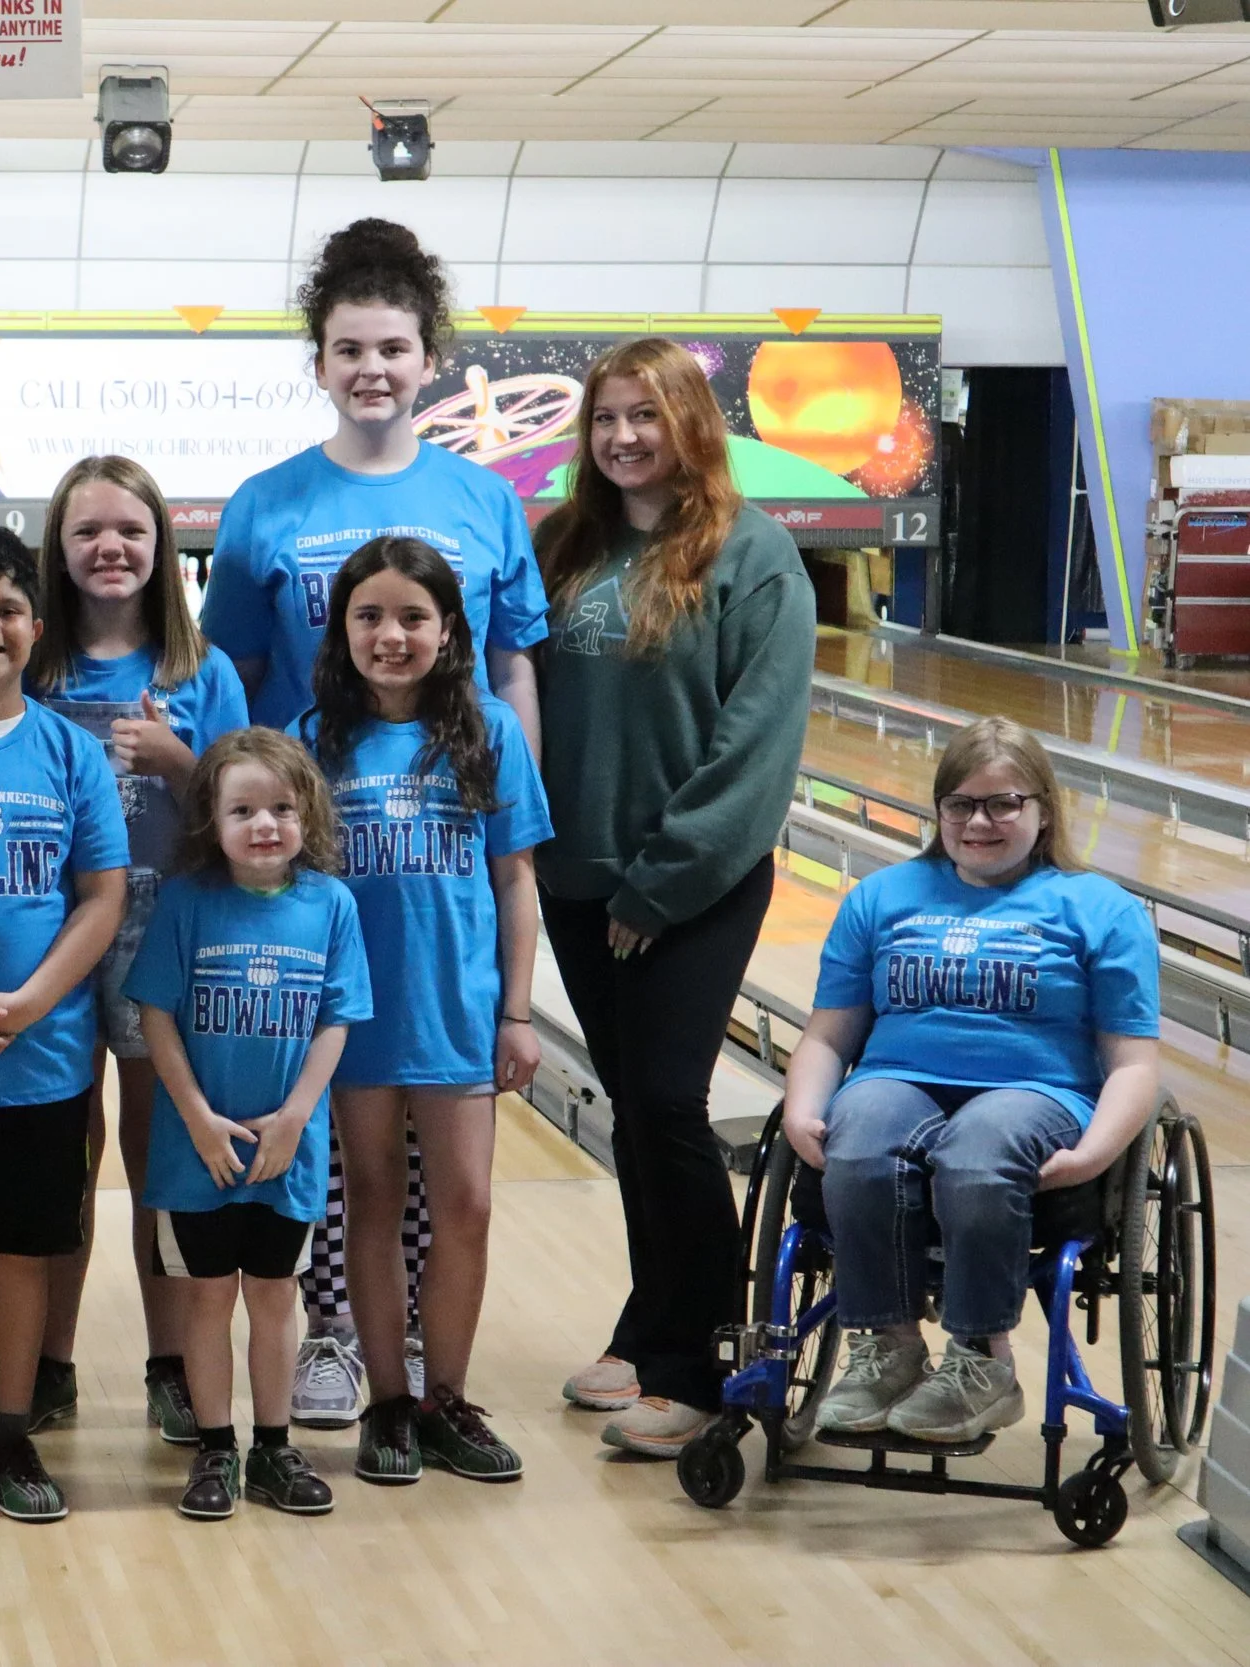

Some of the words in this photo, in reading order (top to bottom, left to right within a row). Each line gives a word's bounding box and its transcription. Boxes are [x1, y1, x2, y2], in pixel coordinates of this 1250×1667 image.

[43, 0, 63, 15] IN
[19, 379, 91, 410] CALL
[100, 378, 168, 416] (501)
[5, 510, 25, 537] 9
[772, 510, 823, 523] AMF
[891, 511, 928, 542] 12
[296, 528, 372, 549] COMMUNITY
[887, 953, 1039, 1013] BOWLING
[192, 983, 321, 1040] BOWLING
